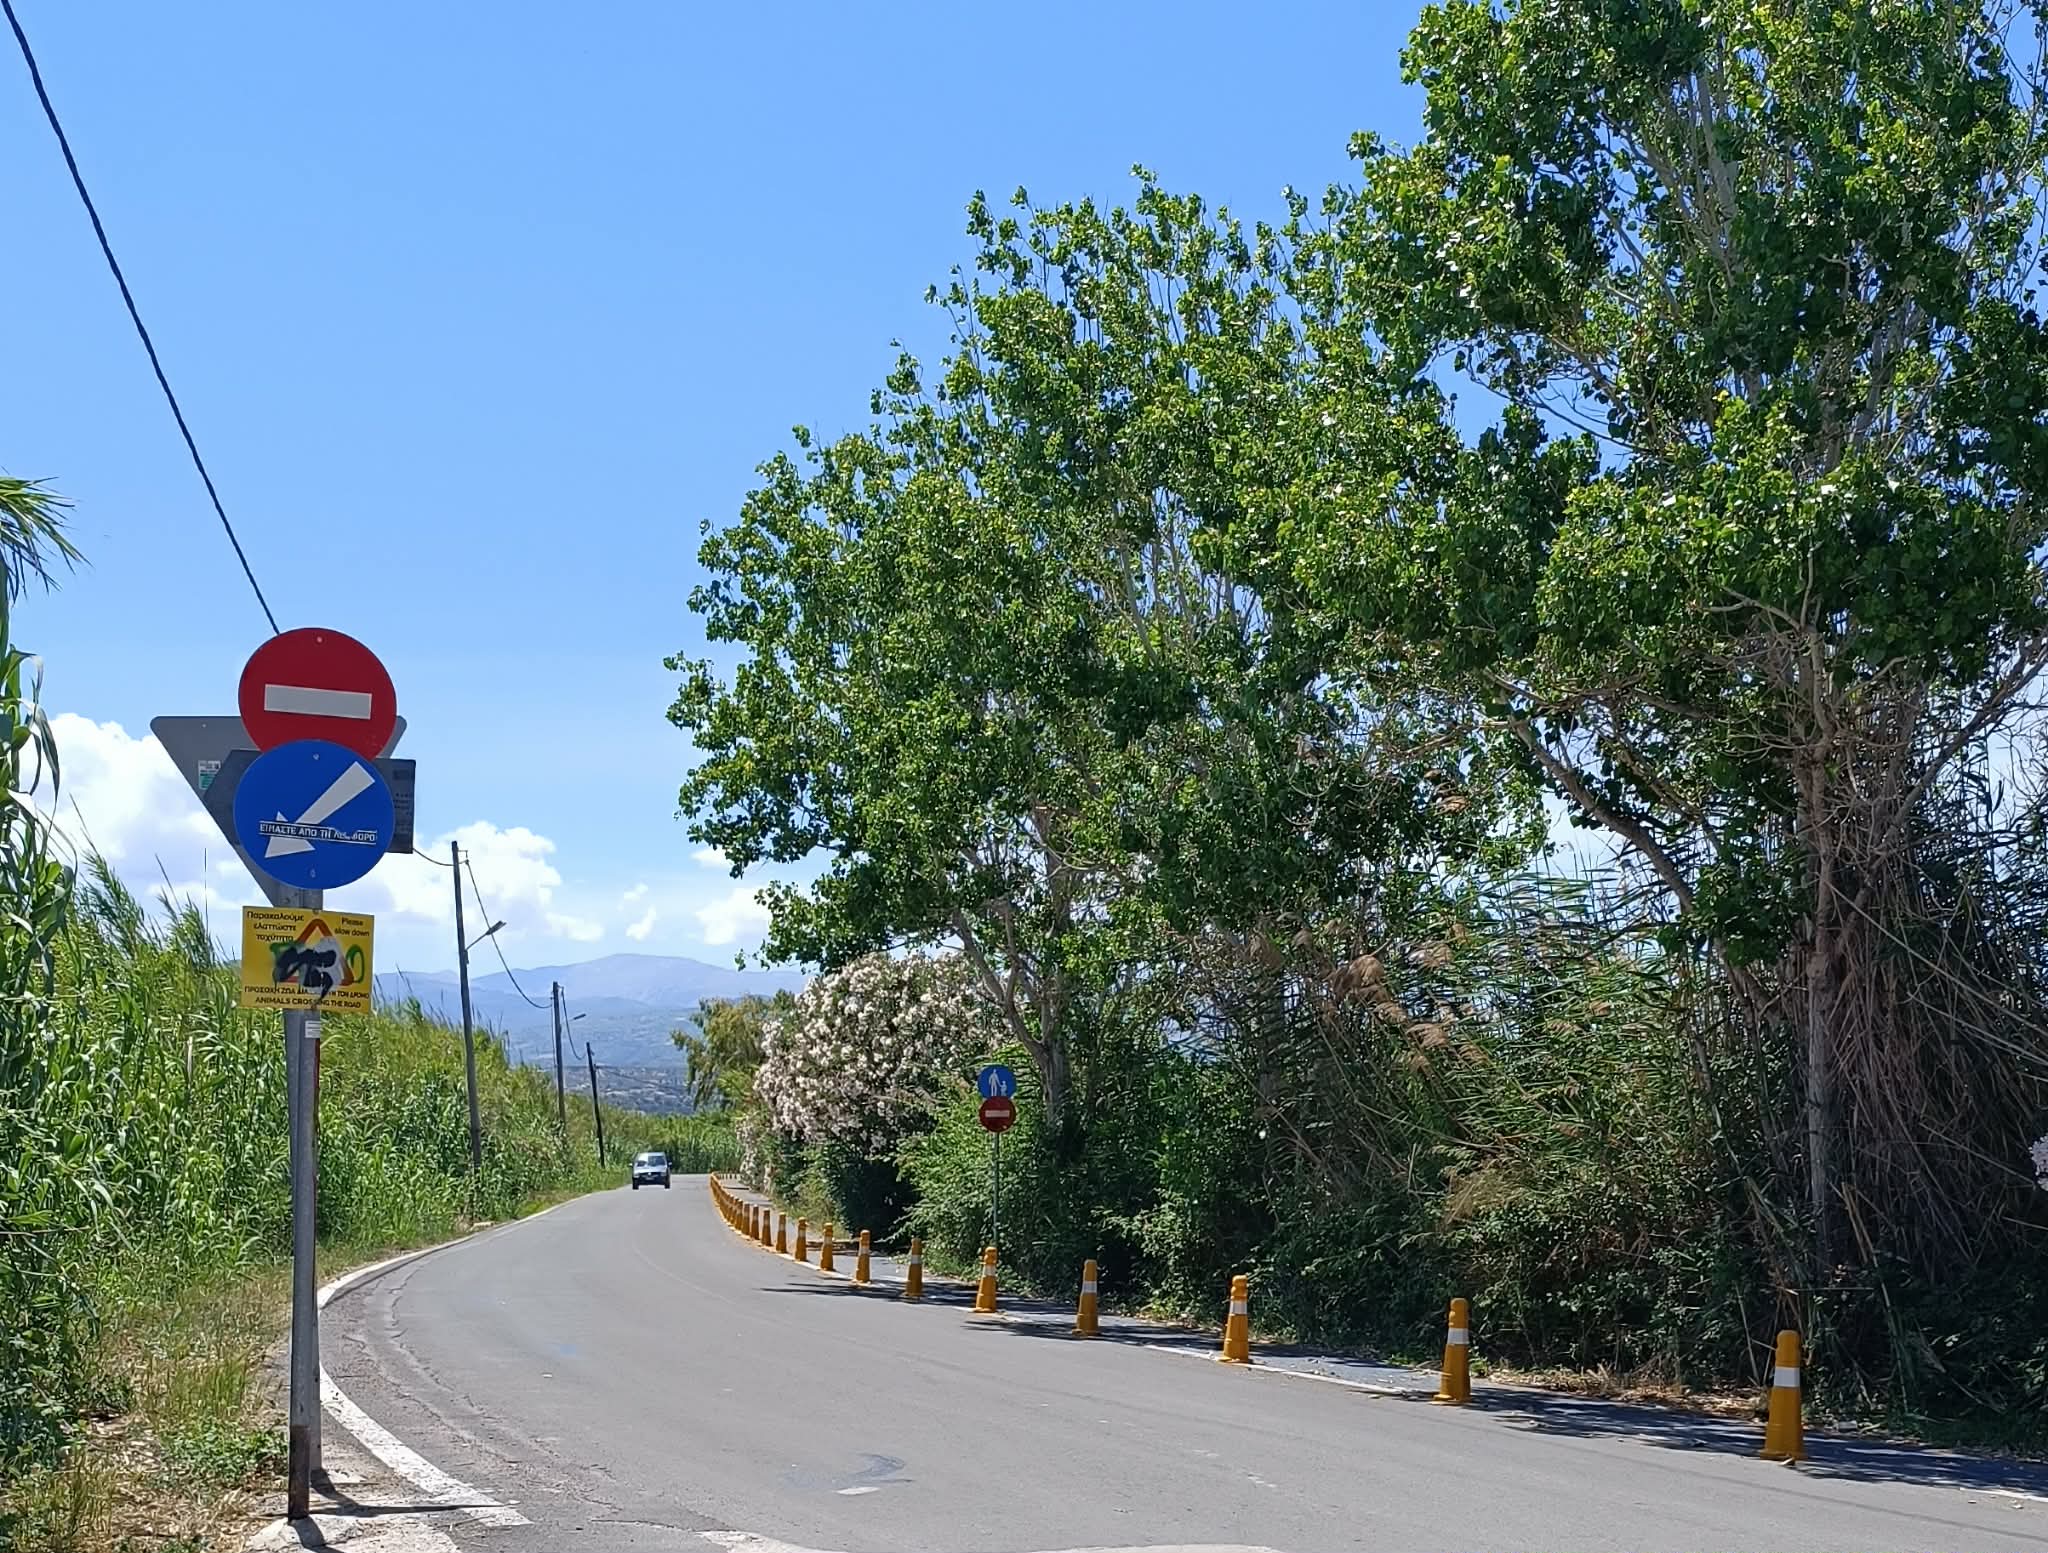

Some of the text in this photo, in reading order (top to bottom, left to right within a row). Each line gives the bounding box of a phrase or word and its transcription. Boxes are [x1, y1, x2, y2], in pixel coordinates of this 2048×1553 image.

[260, 823, 297, 835] ΕΙΜΑΣΤΕ
[298, 827, 318, 837] ΑΠΟ
[320, 829, 332, 839] ΤΗ
[246, 910, 305, 922] Παρακαλούμε
[351, 929, 370, 937] down
[255, 996, 291, 1005] ANIMALS
[331, 999, 343, 1007] THE
[344, 1000, 361, 1009] ROAD
